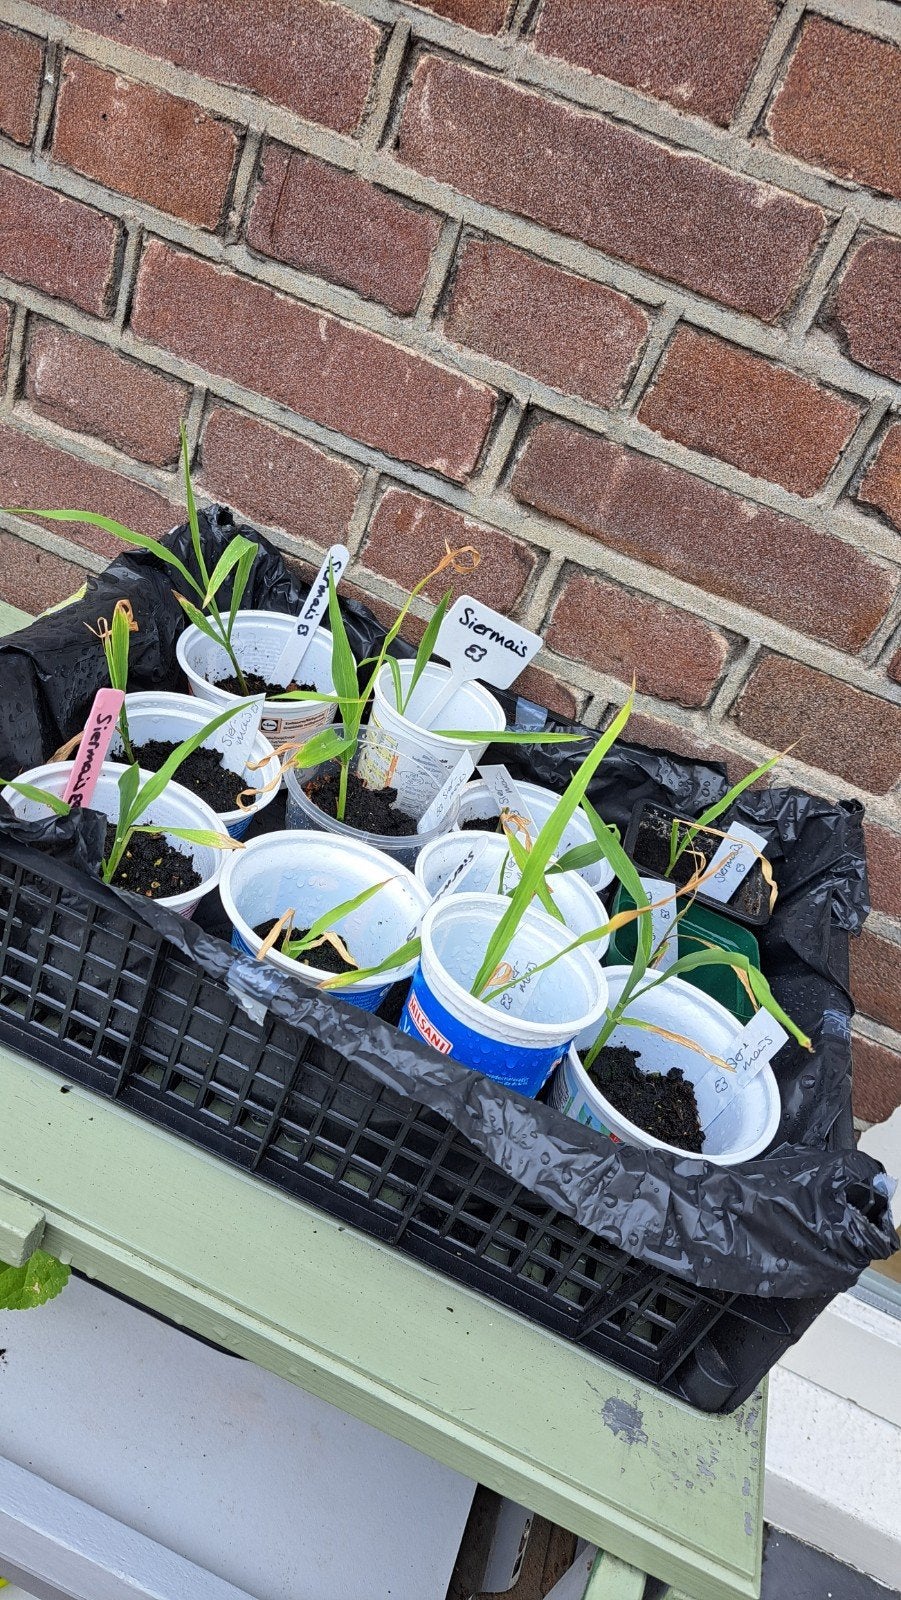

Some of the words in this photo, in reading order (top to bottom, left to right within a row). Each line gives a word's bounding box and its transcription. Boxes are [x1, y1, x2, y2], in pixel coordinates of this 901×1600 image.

[459, 607, 528, 658] Siermais
[73, 713, 113, 791] Siermais
[409, 998, 446, 1052] MILSANI
